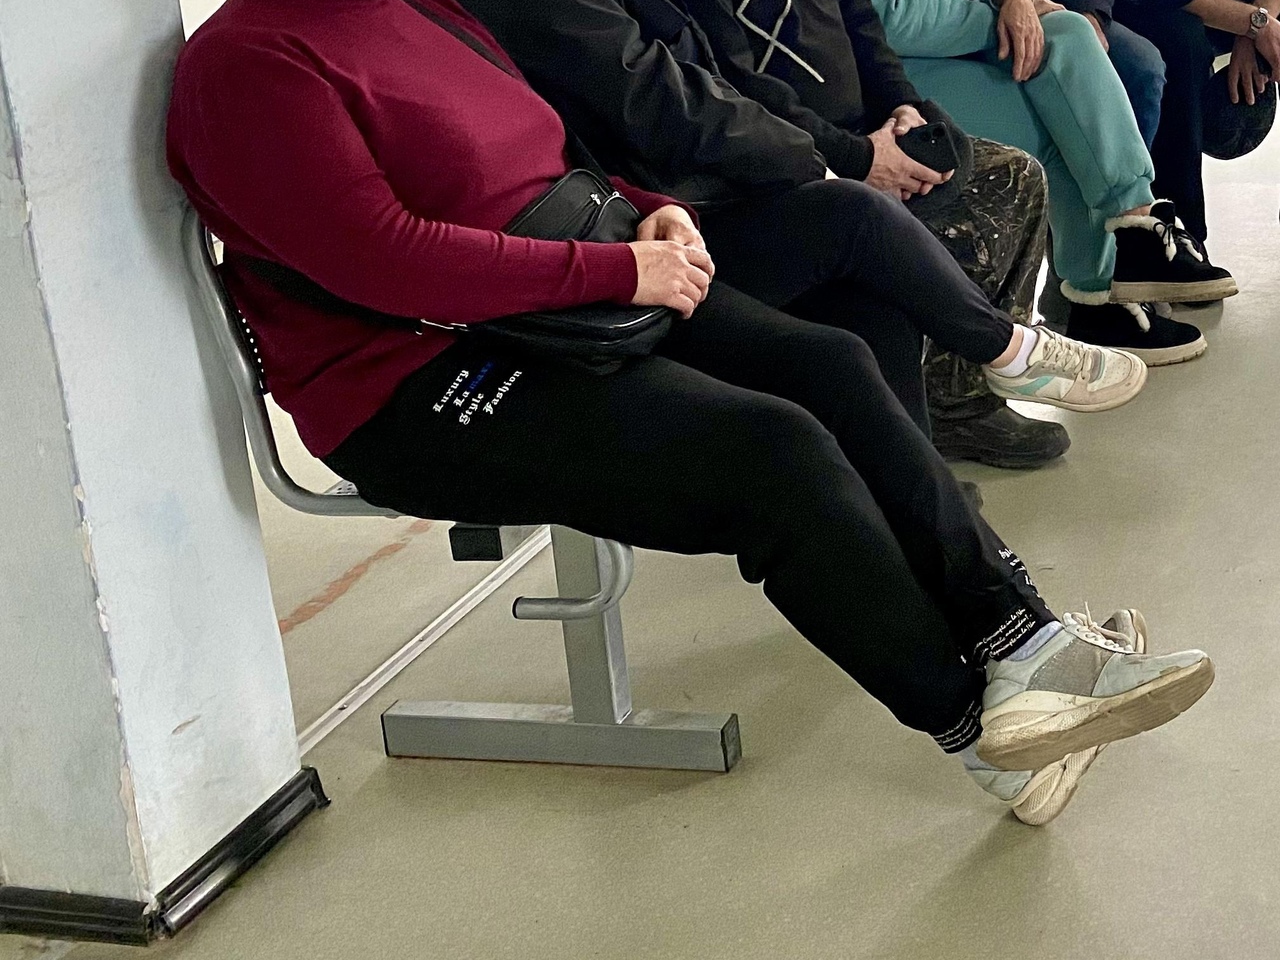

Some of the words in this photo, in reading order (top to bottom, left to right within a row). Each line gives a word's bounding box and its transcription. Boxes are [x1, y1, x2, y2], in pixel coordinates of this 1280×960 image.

[432, 369, 469, 413] Luxury
[453, 390, 471, 407] La
[459, 393, 484, 425] Style
[483, 370, 522, 415] Fashion
